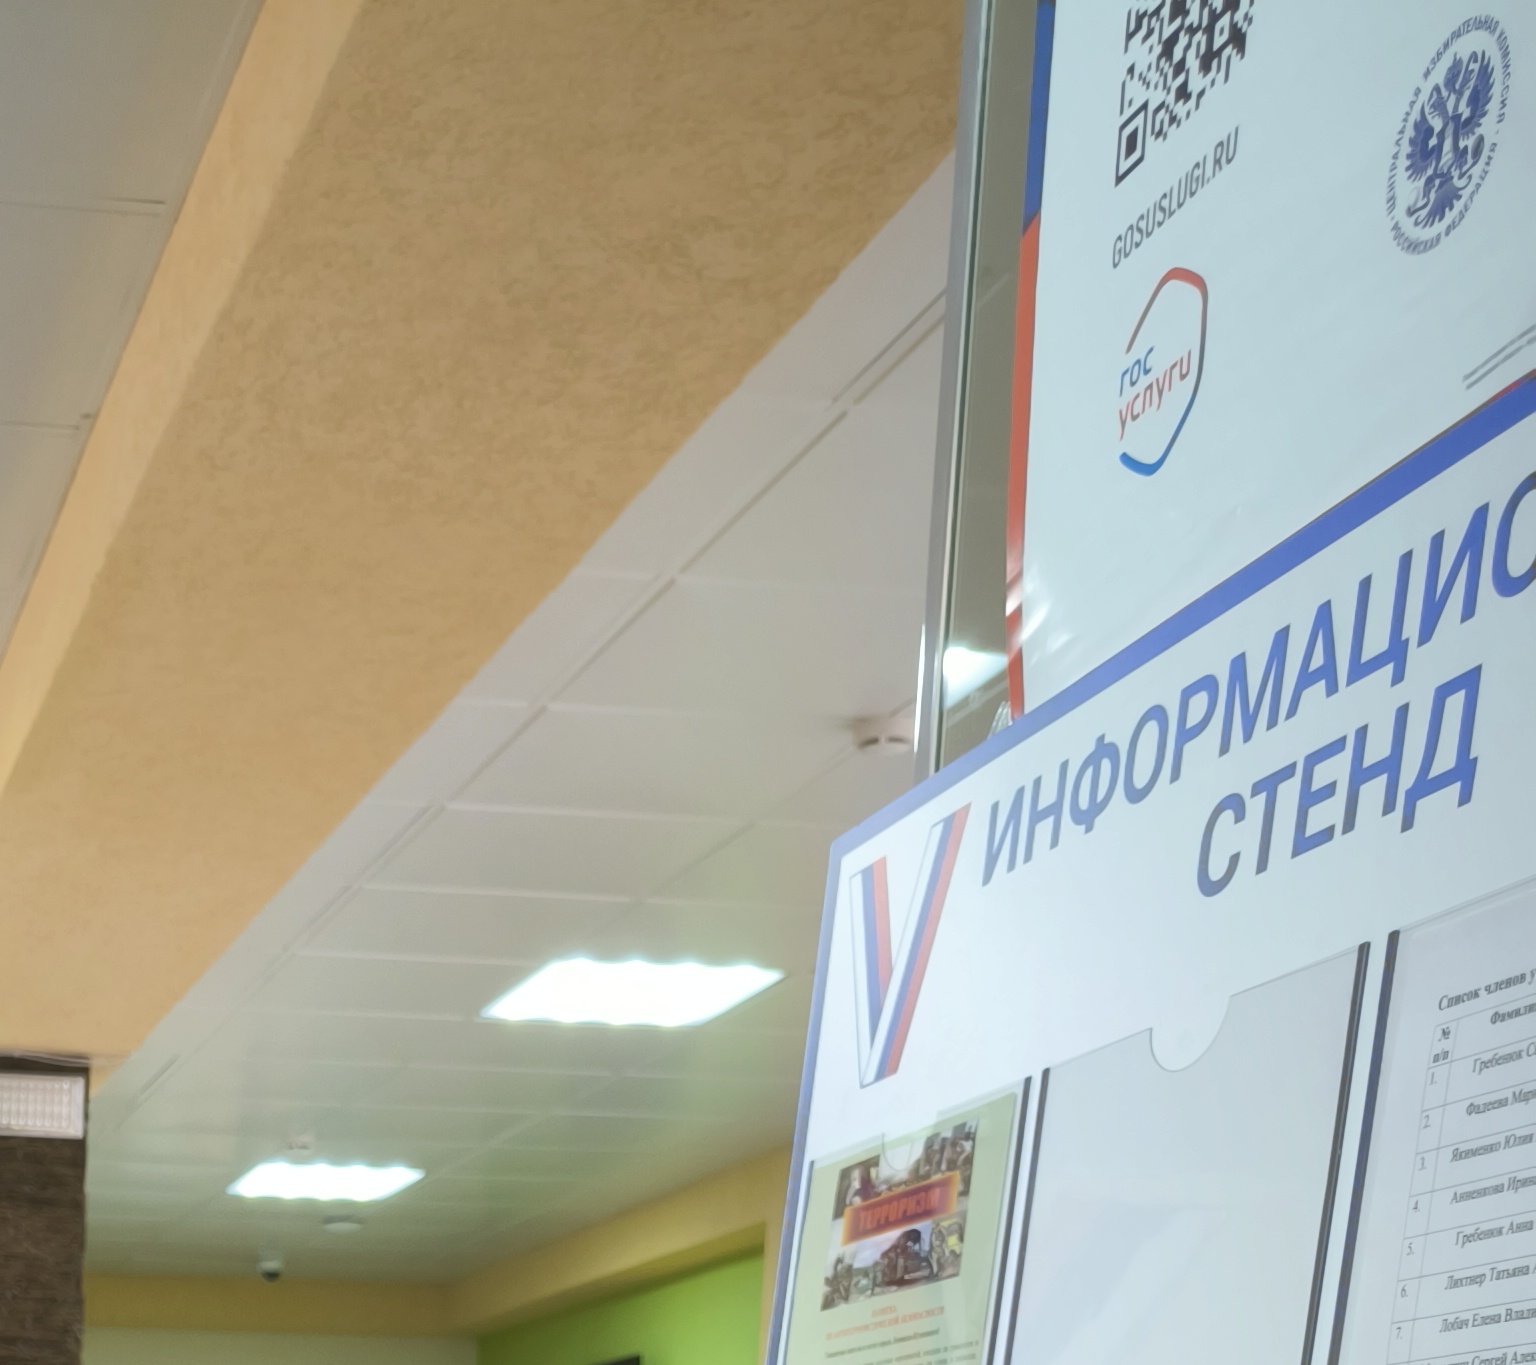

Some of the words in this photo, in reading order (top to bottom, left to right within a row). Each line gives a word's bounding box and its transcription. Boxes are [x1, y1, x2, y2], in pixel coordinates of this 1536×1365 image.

[1423, 13, 1499, 82] ИЗБИРАТЕЛЬНАЯ
[1496, 27, 1513, 125] КОМИССИЯ
[1112, 124, 1240, 269] GOSUSLUGI.RU
[1444, 142, 1498, 238] ФЕДЕРАЦИЯ
[1119, 345, 1155, 398] гос
[1119, 348, 1192, 441] услуги
[981, 470, 1536, 888] ИНФОРМАЦИО
[1196, 662, 1483, 898] СТЕНД
[1438, 986, 1482, 1011] Список
[1483, 971, 1527, 996] членов
[1449, 1139, 1502, 1164] Якименко
[1502, 1132, 1534, 1151] Юлия
[1449, 1182, 1505, 1206] Анненкова
[1454, 1226, 1504, 1249] Гребенюк
[1505, 1219, 1534, 1236] Анна
[1489, 1264, 1531, 1283] Татьяна
[1438, 1316, 1470, 1334] Лобач
[1471, 1312, 1502, 1329] Елена
